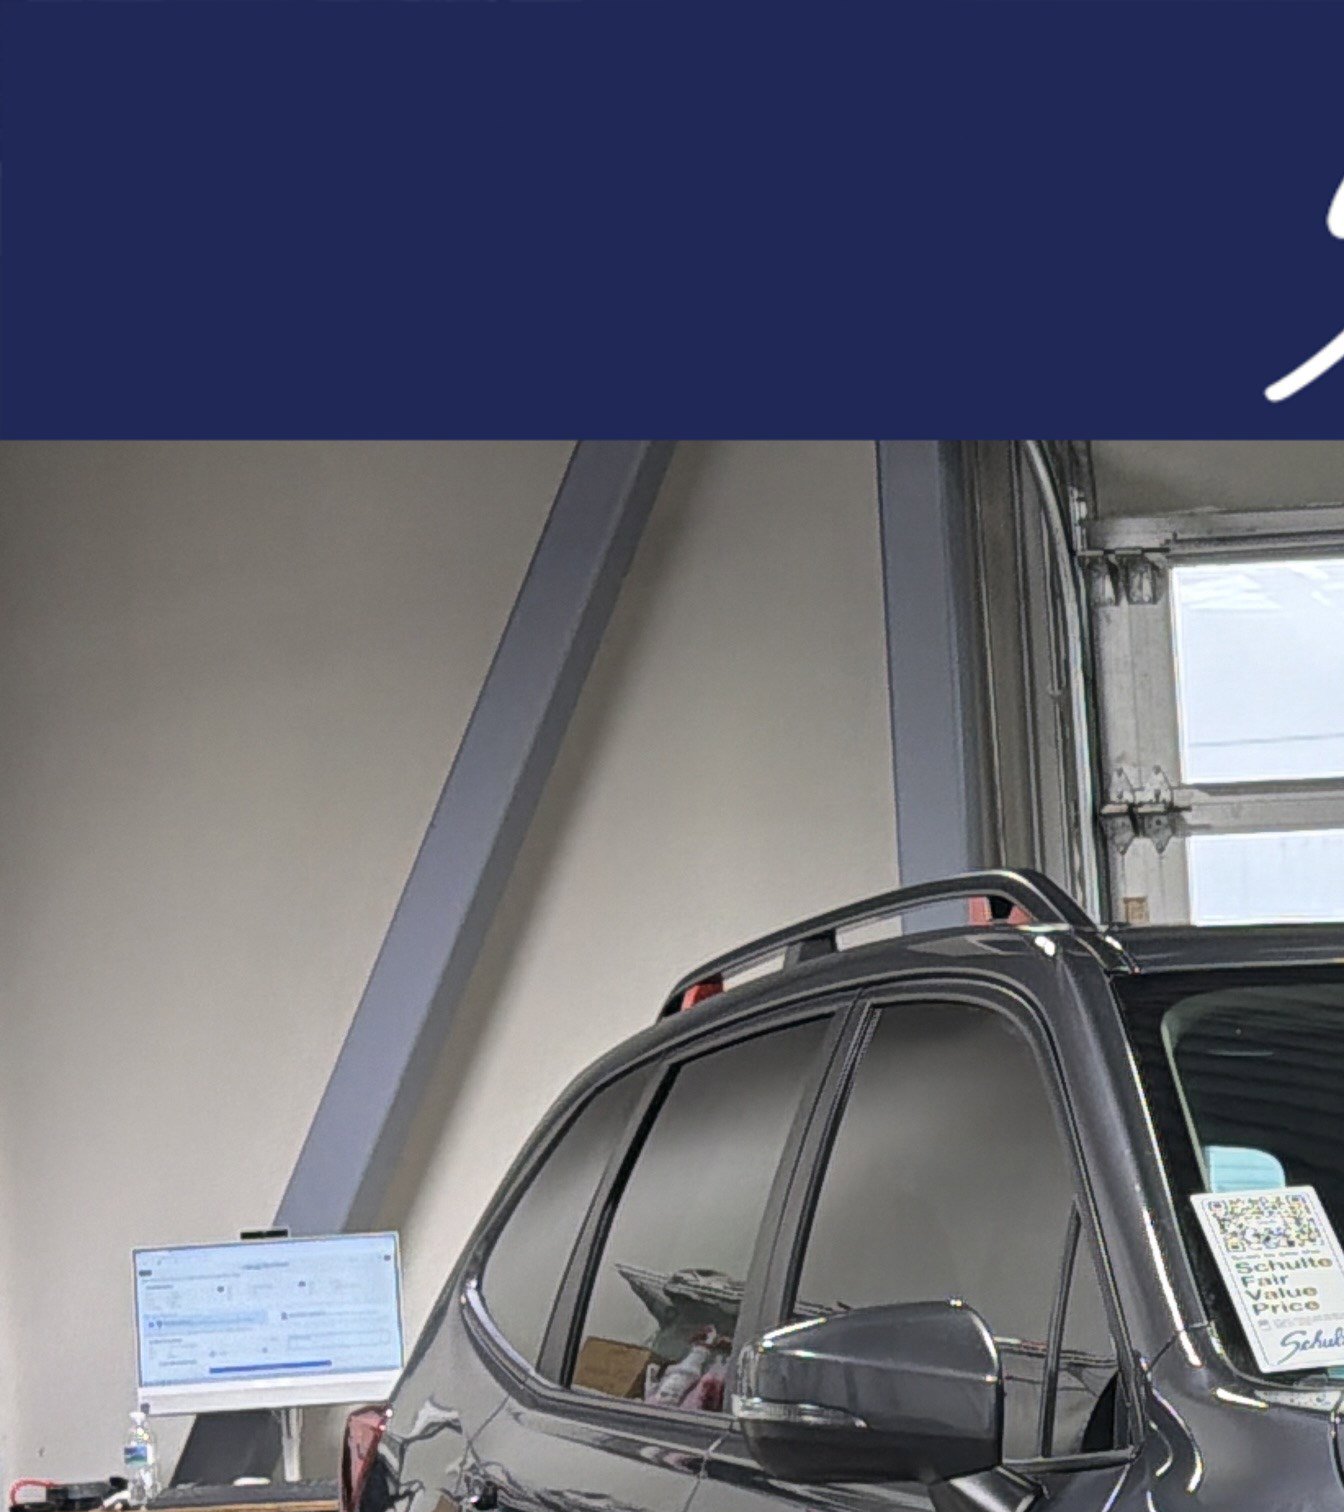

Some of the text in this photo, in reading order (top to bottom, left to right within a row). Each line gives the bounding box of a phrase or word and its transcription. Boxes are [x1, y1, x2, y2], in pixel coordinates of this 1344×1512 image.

[1235, 1256, 1333, 1274] Schulte
[1241, 1273, 1289, 1288] Fair
[1245, 1286, 1319, 1301] Value
[1252, 1300, 1321, 1316] Price
